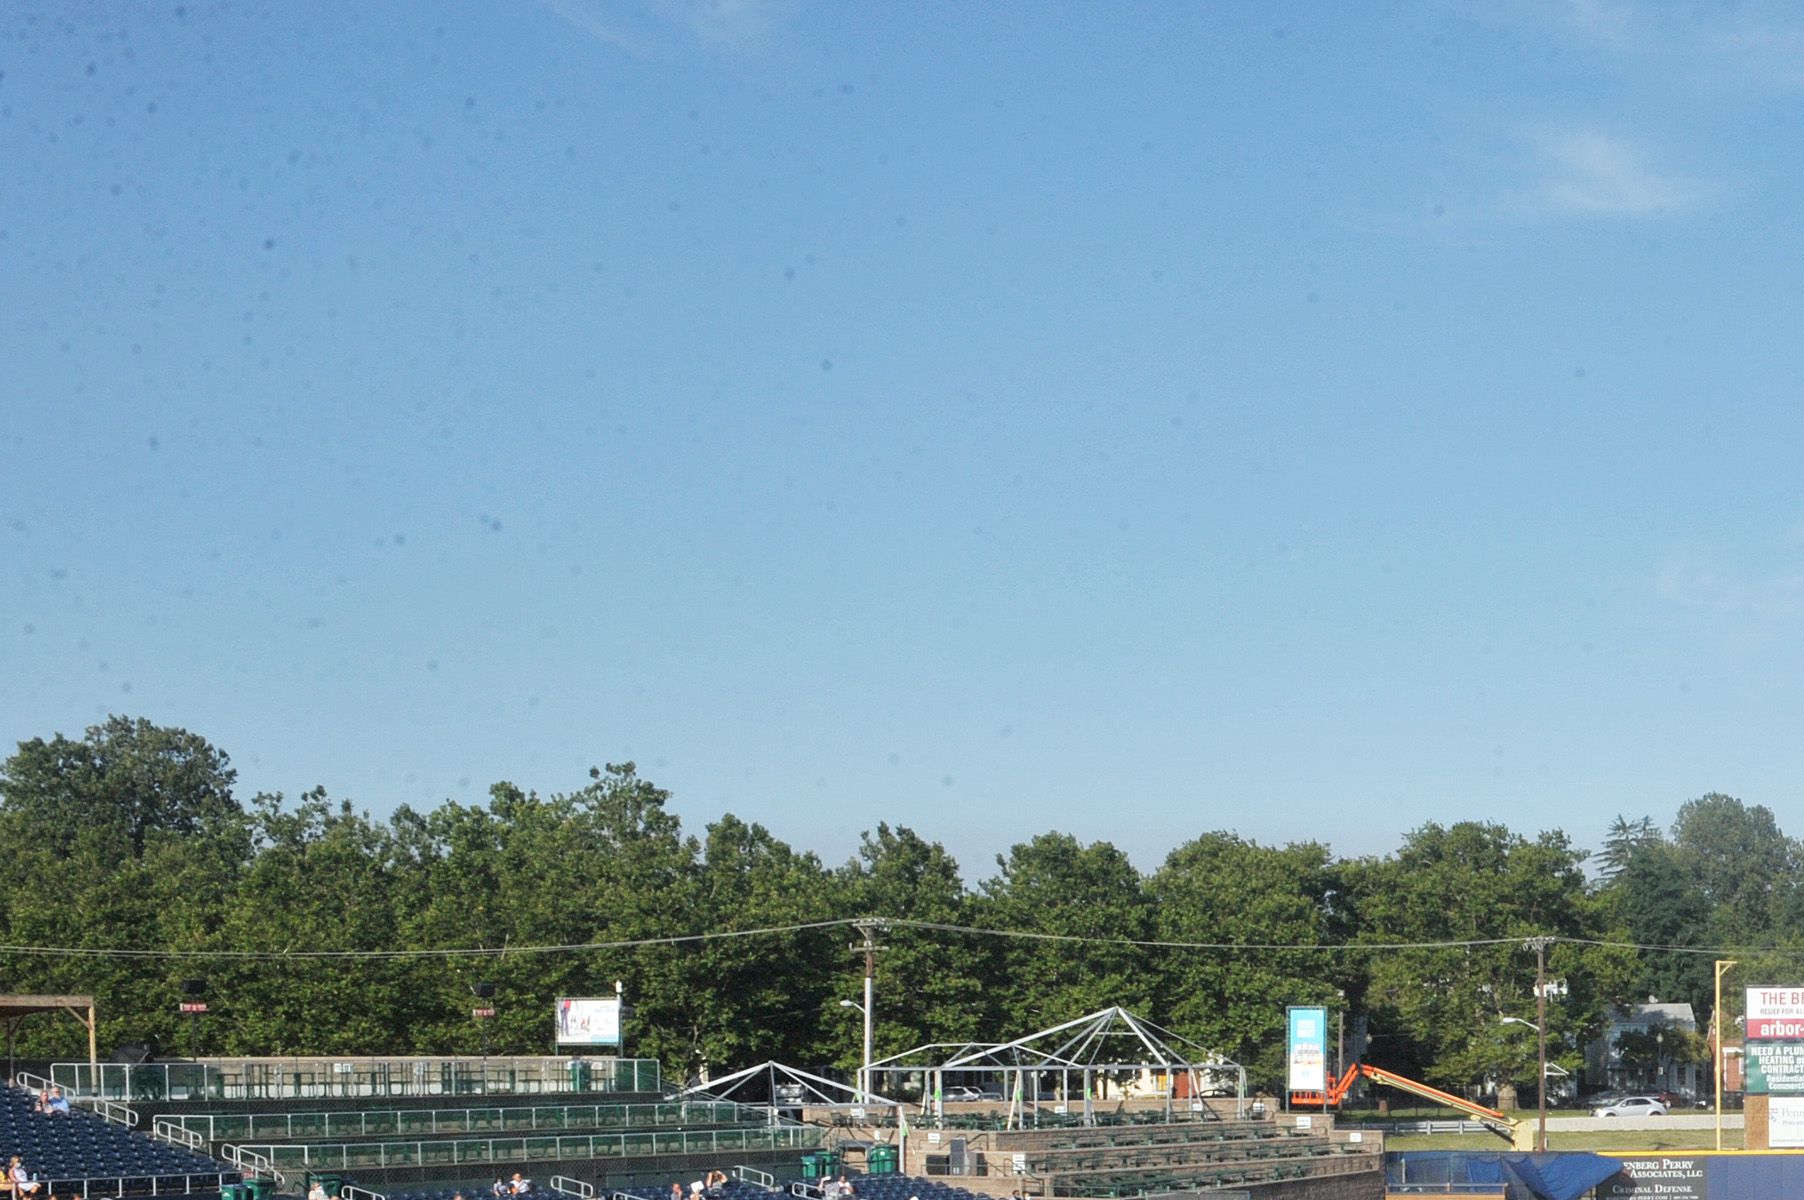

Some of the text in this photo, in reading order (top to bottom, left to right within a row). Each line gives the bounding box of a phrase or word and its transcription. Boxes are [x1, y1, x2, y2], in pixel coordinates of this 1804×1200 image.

[1760, 991, 1787, 1005] THE
[1751, 1047, 1773, 1056] NEED
[1775, 1047, 1782, 1056] A
[1759, 1056, 1795, 1065] HEATING
[1796, 1057, 1804, 1065] or
[1662, 1158, 1694, 1169] PERRY
[1630, 1169, 1703, 1179] ASSOCIATES, LLC
[1654, 1184, 1692, 1193] DEFENSE
